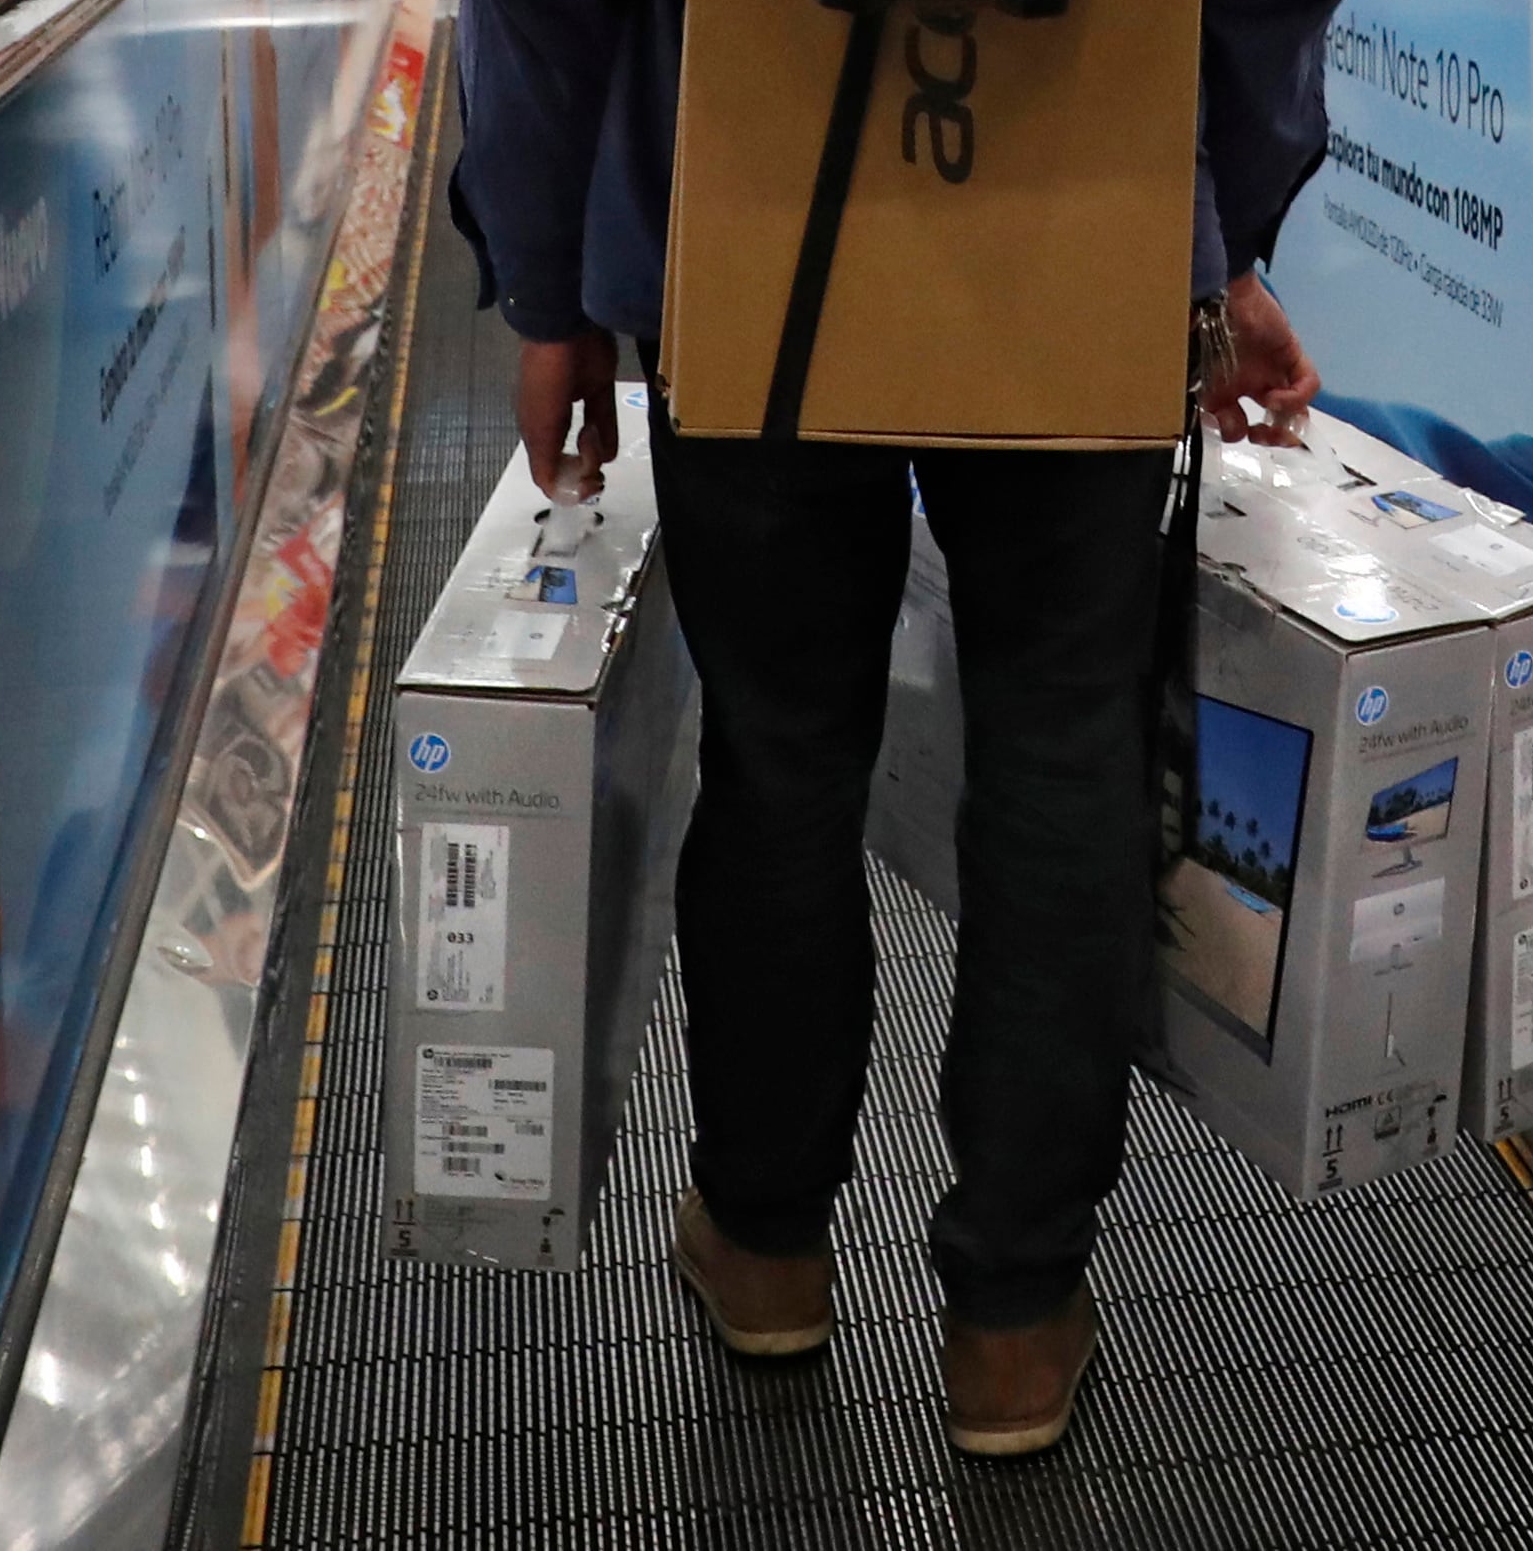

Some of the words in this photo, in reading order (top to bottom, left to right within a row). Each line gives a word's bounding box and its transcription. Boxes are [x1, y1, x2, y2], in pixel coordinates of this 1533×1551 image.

[1381, 25, 1430, 112] Note
[1436, 47, 1462, 125] 10
[1467, 58, 1505, 145] Pro
[1367, 141, 1380, 185] tu
[1382, 159, 1425, 211] mundo
[1425, 179, 1451, 226] con
[1453, 185, 1505, 253] 108MP
[1504, 650, 1533, 689] hp
[1356, 686, 1389, 726] hp
[1398, 723, 1428, 747] with
[1429, 713, 1471, 736] Audio
[412, 736, 449, 770] hp
[414, 782, 462, 803] 24fw
[464, 784, 505, 807] with
[507, 787, 561, 810] Audio
[446, 931, 474, 945] 033
[1325, 1159, 1338, 1180] 5
